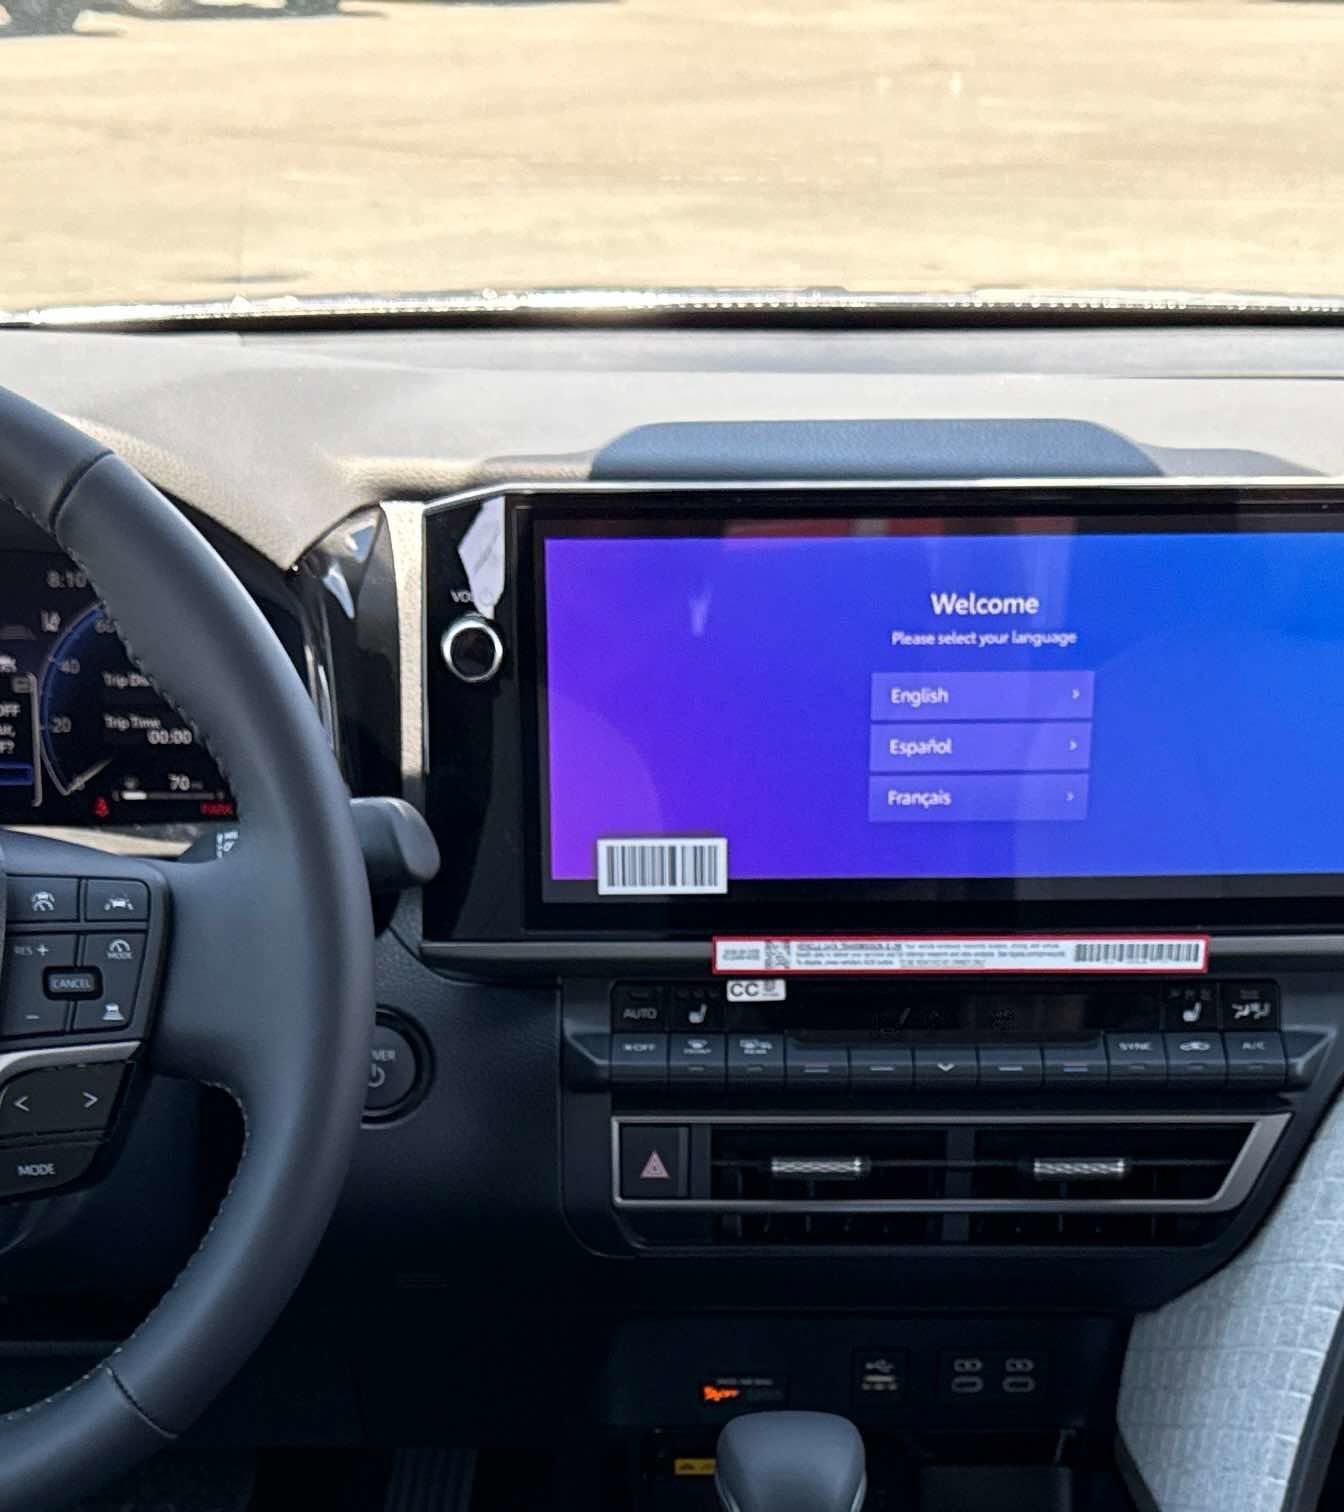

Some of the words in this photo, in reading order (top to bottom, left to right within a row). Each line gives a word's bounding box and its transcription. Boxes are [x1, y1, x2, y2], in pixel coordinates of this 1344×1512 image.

[930, 593, 1040, 615] Welcome
[891, 631, 935, 645] Please
[937, 631, 976, 645] select
[979, 633, 1009, 648] your
[1011, 631, 1077, 647] language
[890, 688, 949, 706] English
[889, 739, 952, 756] Español
[887, 790, 952, 808] Français
[53, 977, 92, 989] CANCEL
[730, 982, 760, 998] CC
[623, 1008, 657, 1019] AUTO
[17, 1163, 55, 1177] MODE
